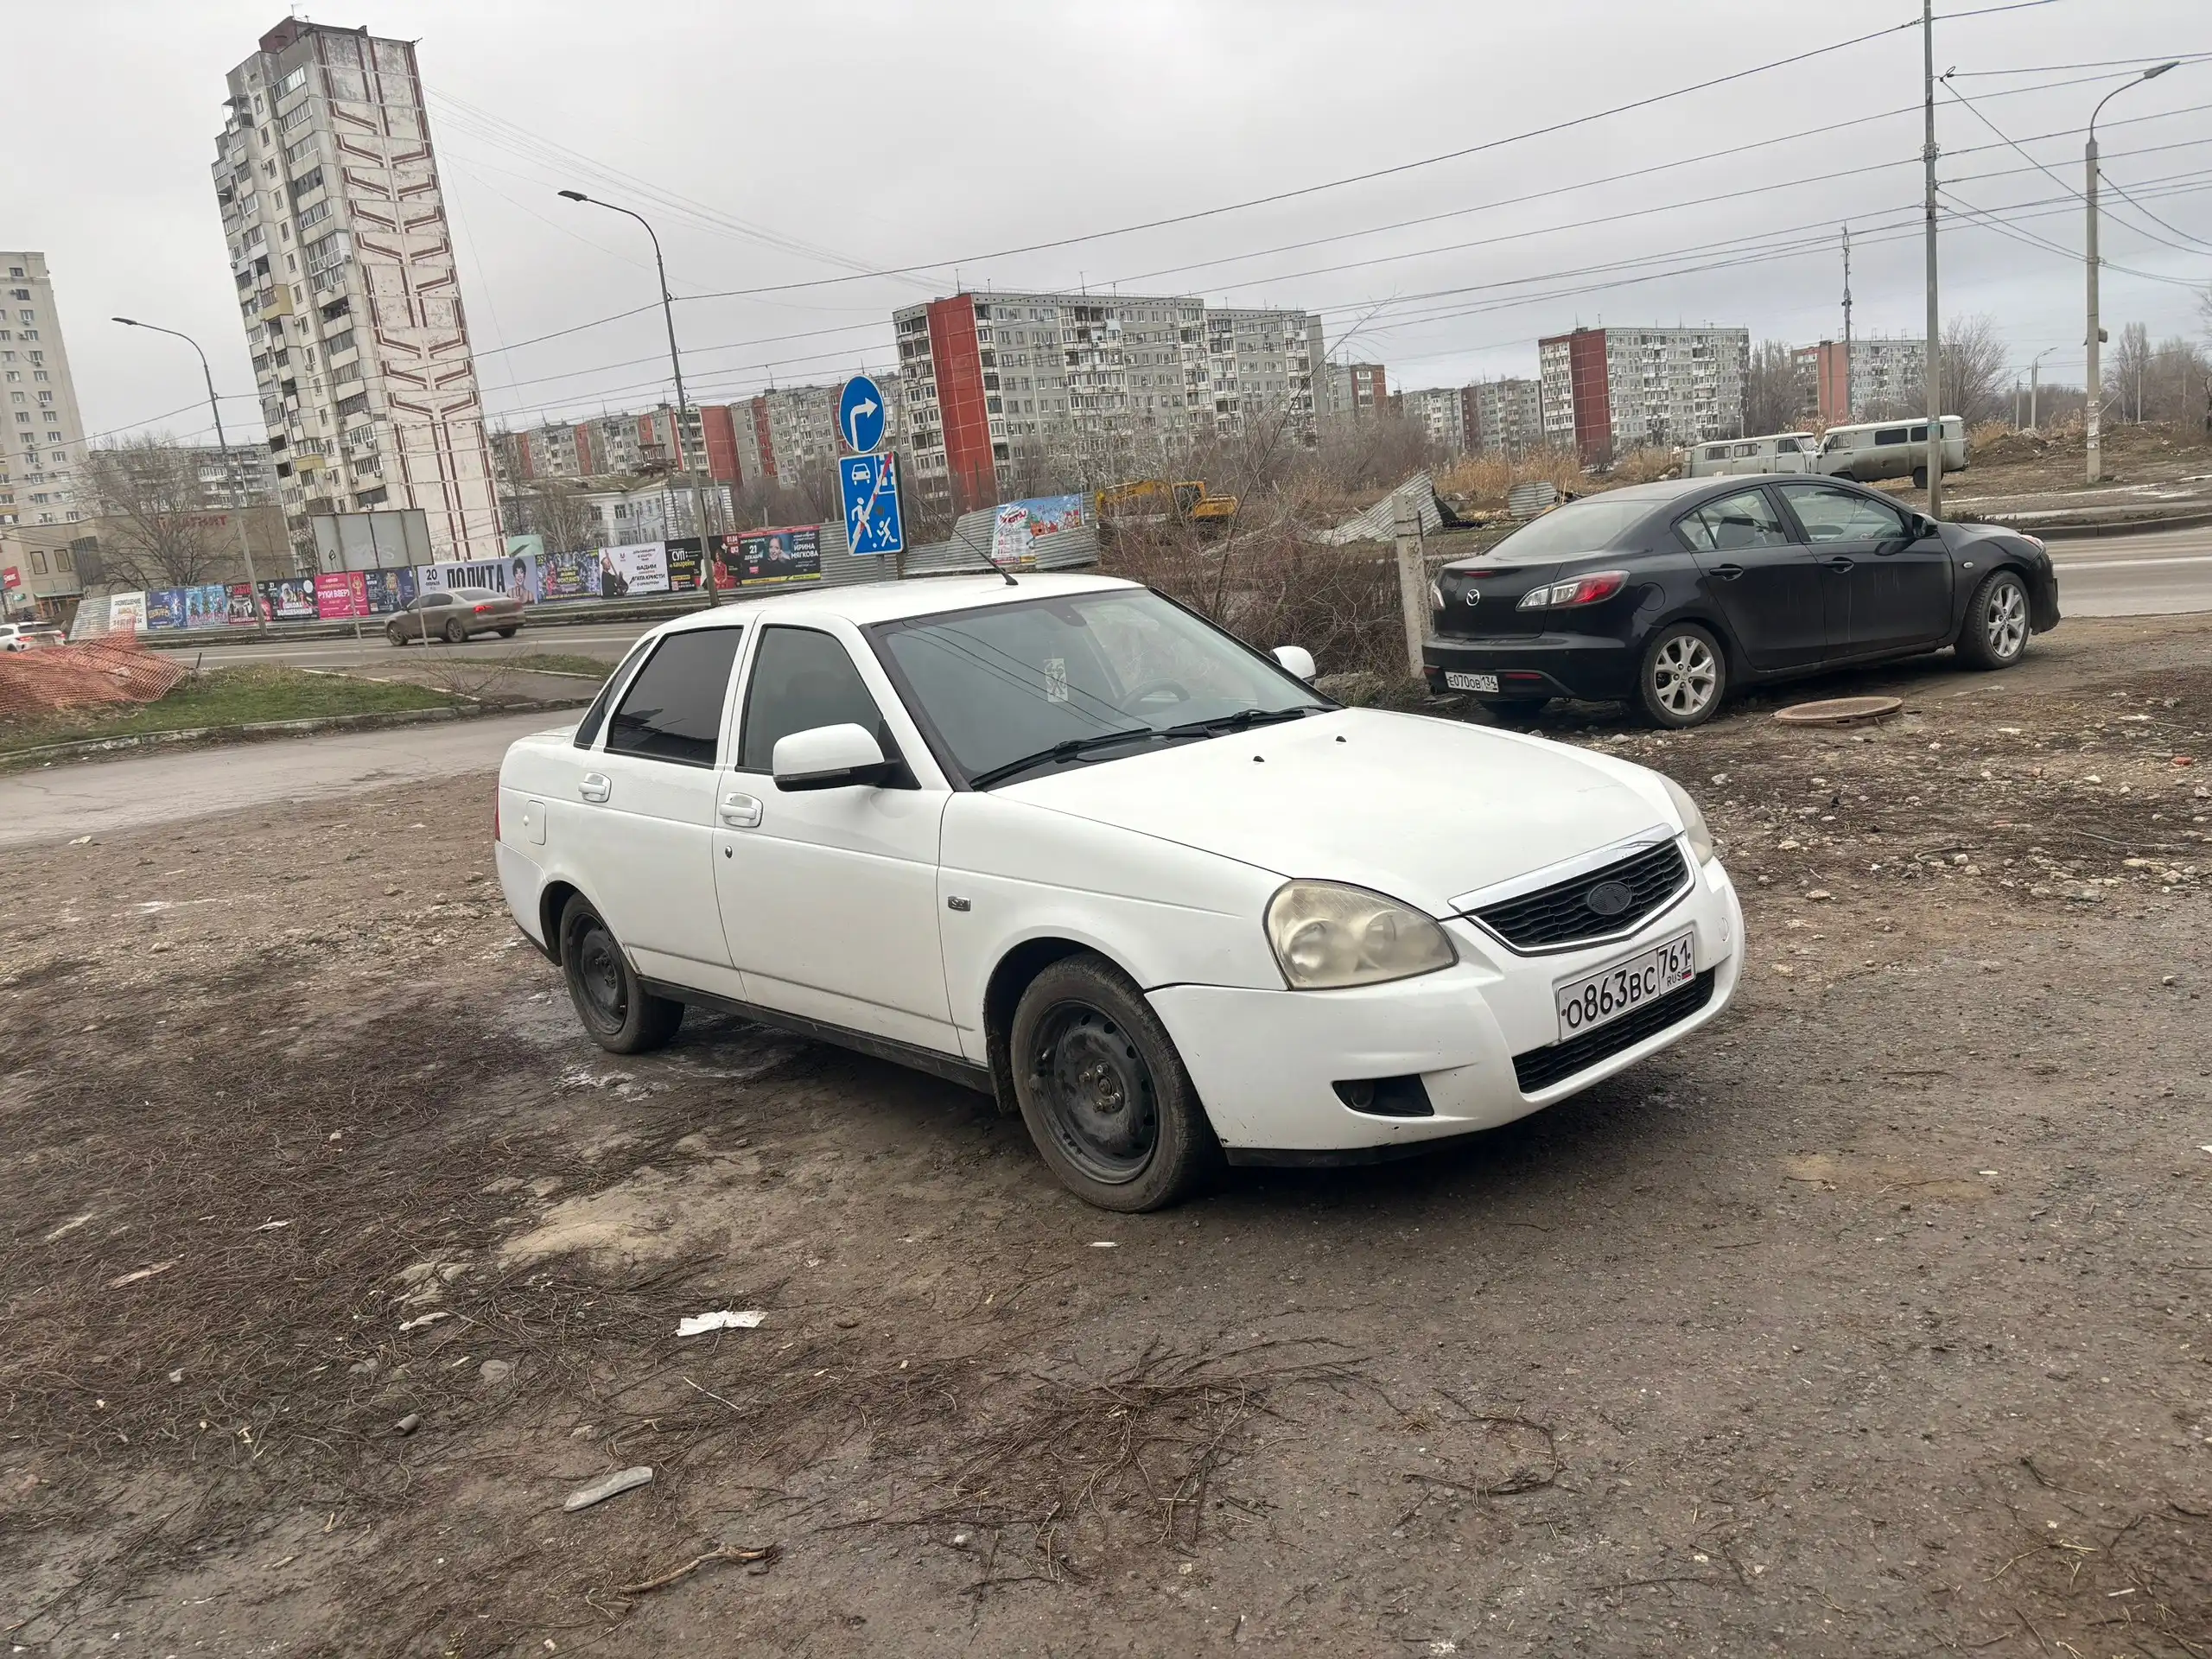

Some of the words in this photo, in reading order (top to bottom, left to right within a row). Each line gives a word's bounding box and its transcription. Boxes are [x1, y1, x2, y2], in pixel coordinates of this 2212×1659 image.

[749, 544, 758, 554] 21
[793, 543, 816, 551] ИРИНА
[791, 550, 819, 559] МЯГКОВА
[426, 569, 438, 581] 20
[317, 590, 334, 600] РУКИ
[1667, 970, 1681, 987] RUS
